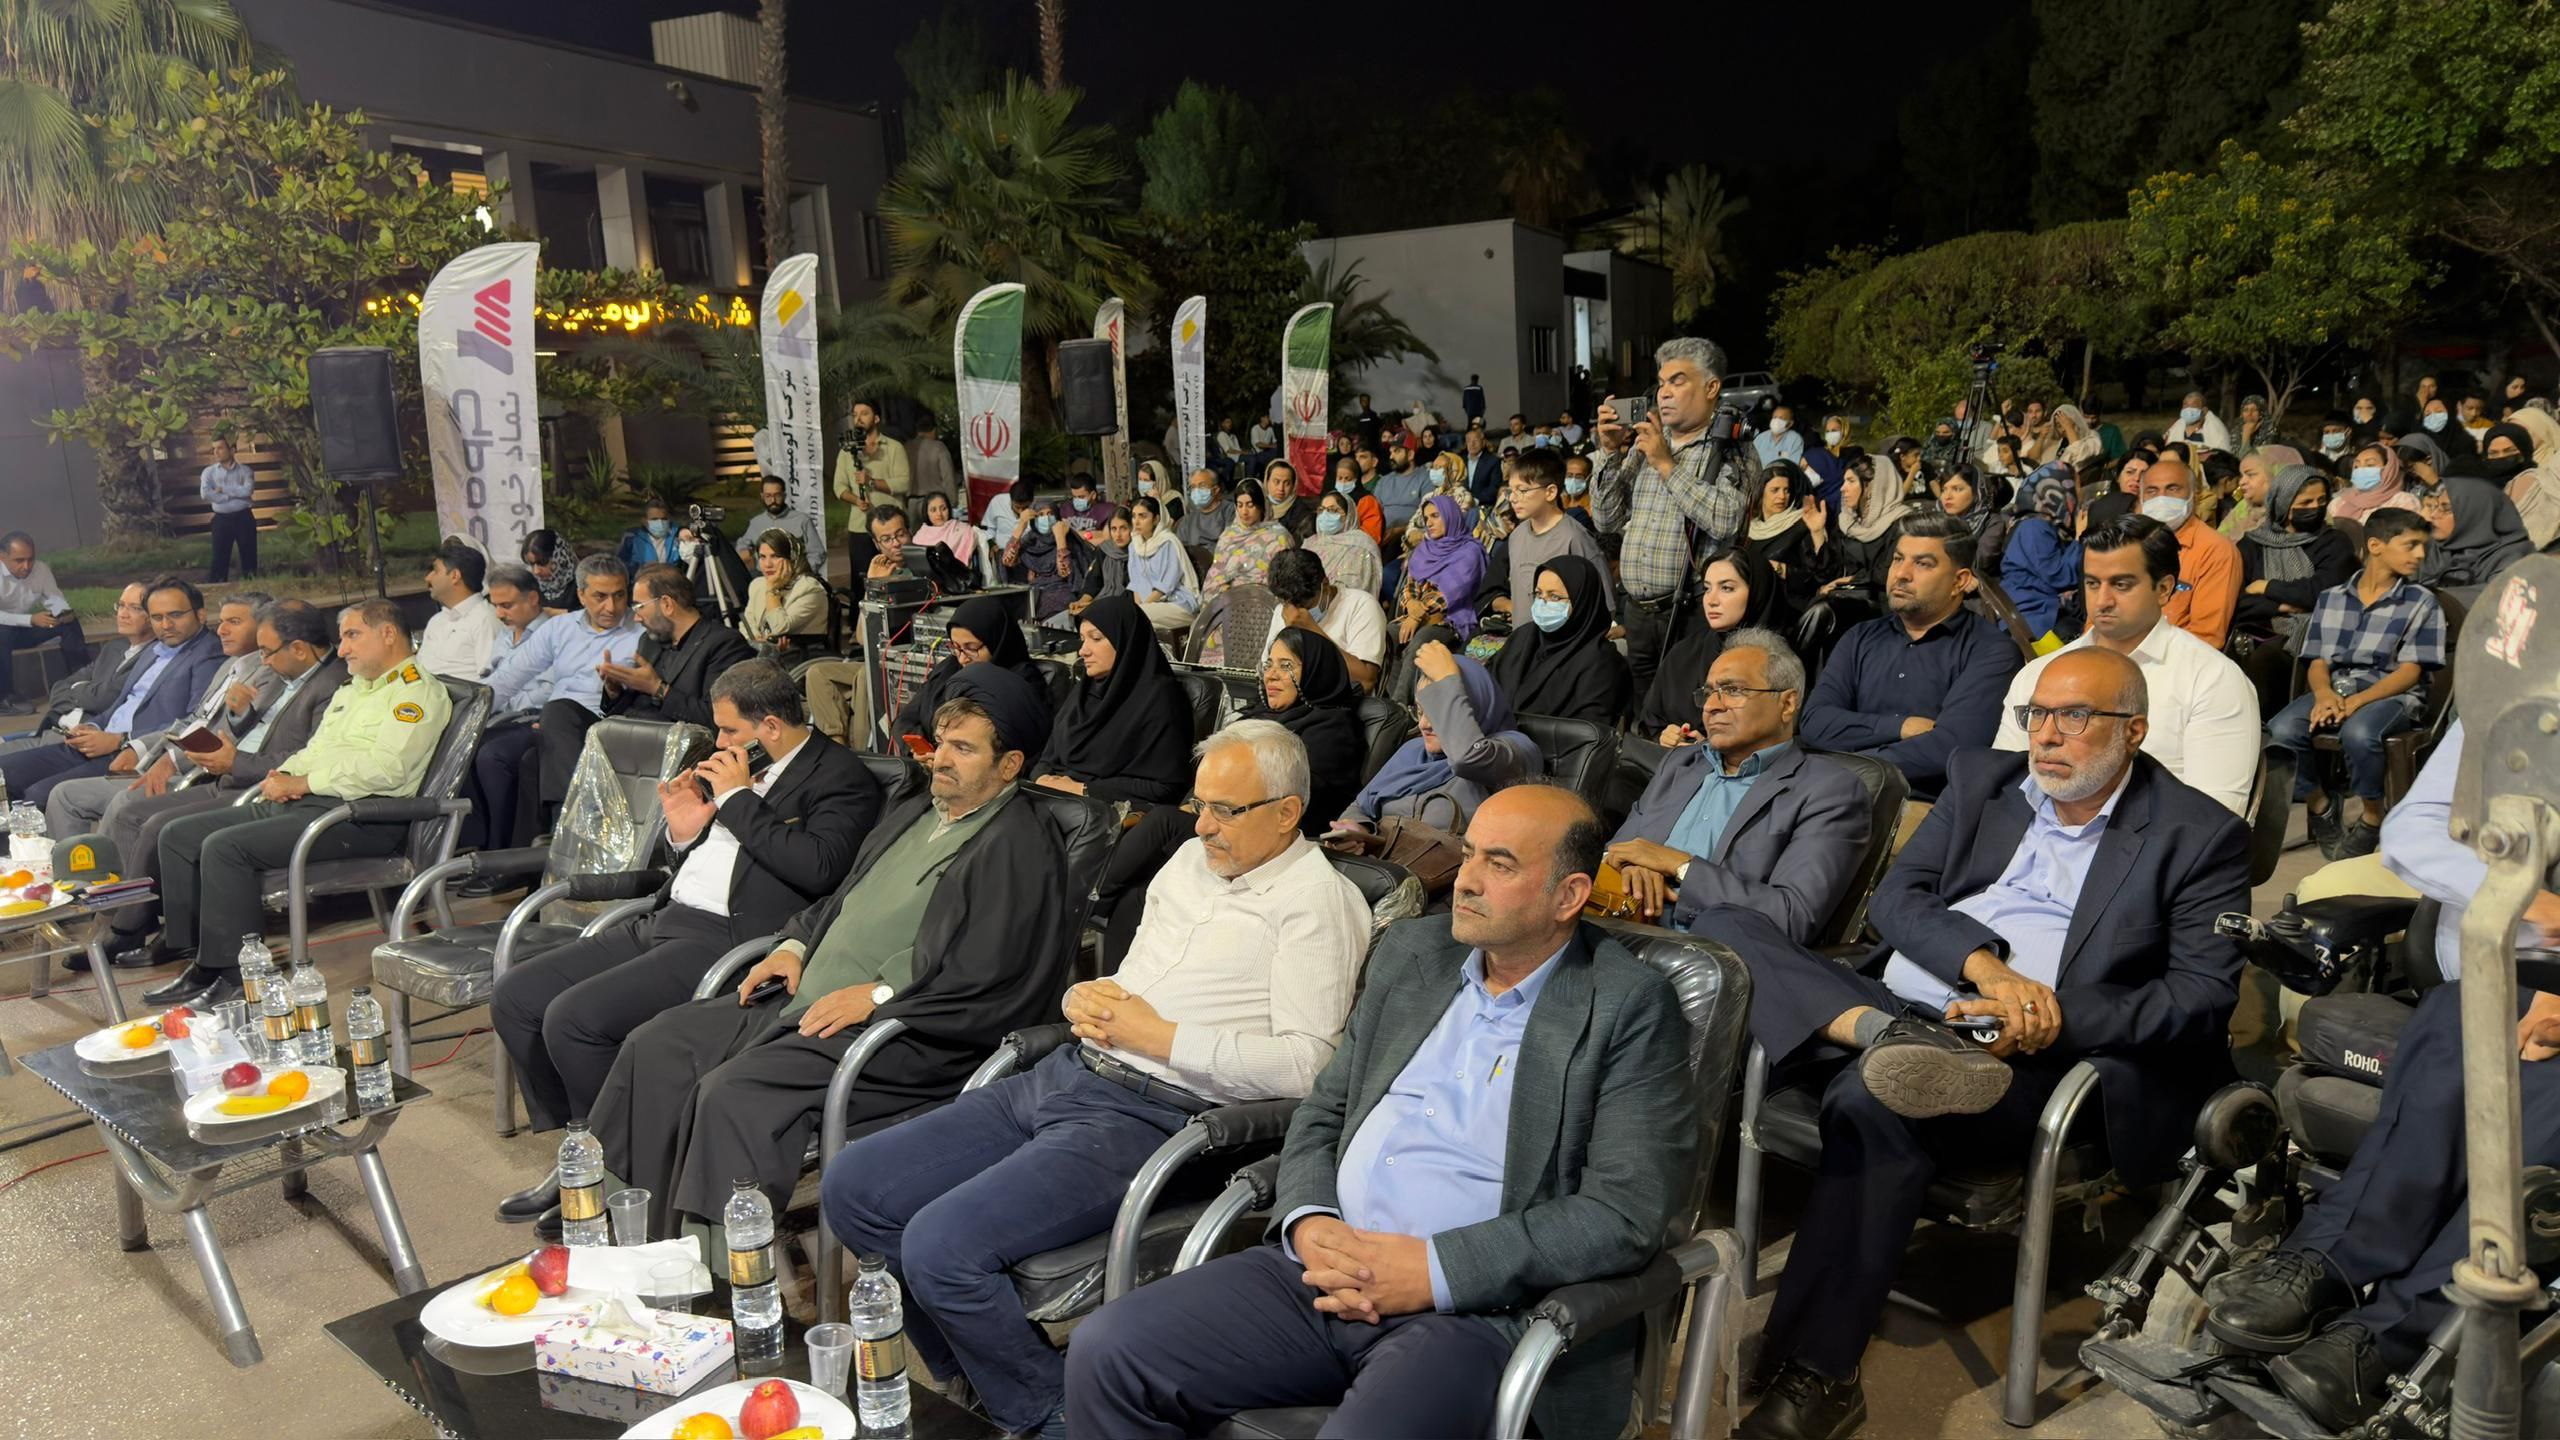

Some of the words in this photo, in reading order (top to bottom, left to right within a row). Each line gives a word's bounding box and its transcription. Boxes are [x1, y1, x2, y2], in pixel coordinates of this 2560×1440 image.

[499, 391, 522, 461] نماد
[780, 369, 797, 420] شرکت
[781, 422, 799, 497] آلومینیوم
